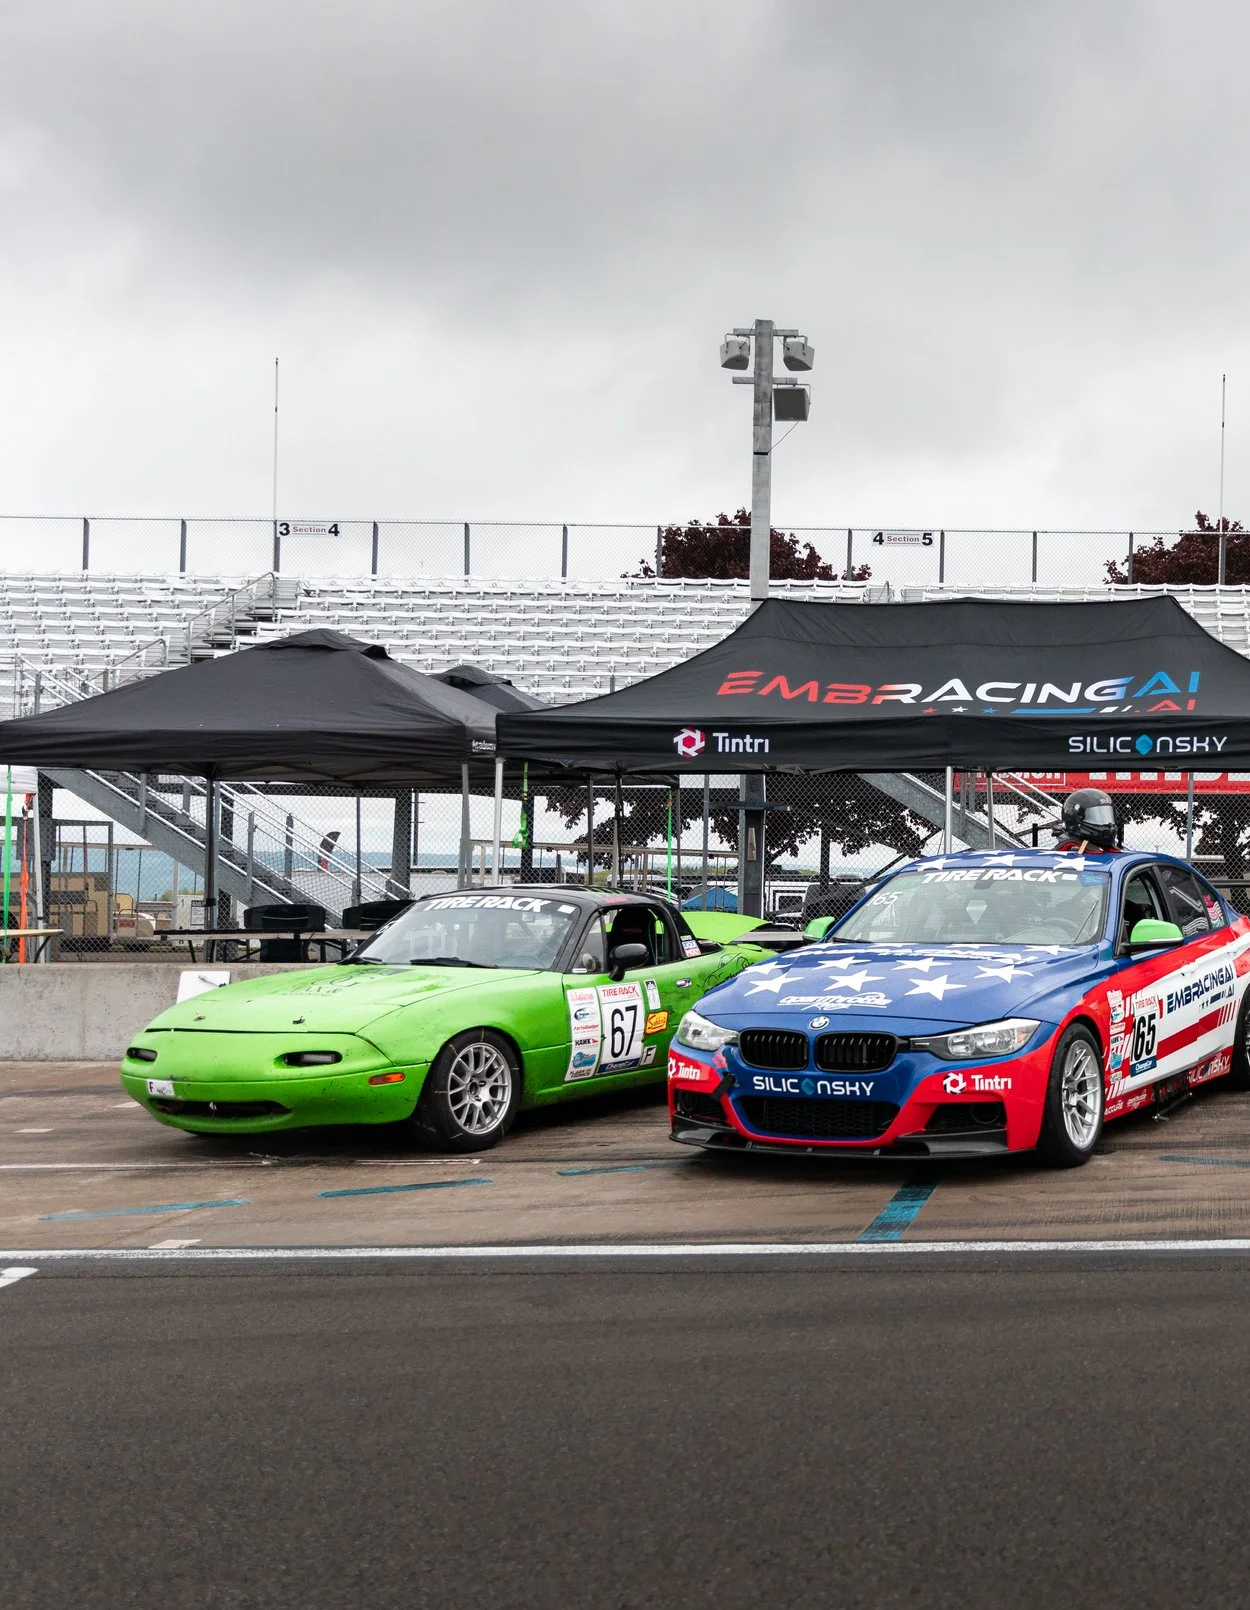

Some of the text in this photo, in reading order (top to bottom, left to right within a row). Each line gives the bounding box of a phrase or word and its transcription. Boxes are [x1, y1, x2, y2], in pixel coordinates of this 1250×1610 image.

[279, 522, 290, 536] 3
[328, 523, 340, 536] 4
[873, 532, 884, 545] 4
[922, 533, 933, 546] 5
[712, 732, 769, 753] Tintri
[922, 869, 985, 885] TIRE
[983, 869, 1064, 884] RACK
[424, 896, 552, 913] TIRE RACK
[602, 987, 618, 998] TIRE
[618, 986, 640, 998] RACK
[611, 1004, 638, 1059] 67
[1130, 1013, 1157, 1062] 165
[644, 1047, 657, 1063] F
[678, 1062, 700, 1081] Tintri
[149, 1081, 154, 1092] F
[971, 1074, 1012, 1091] Tintri
